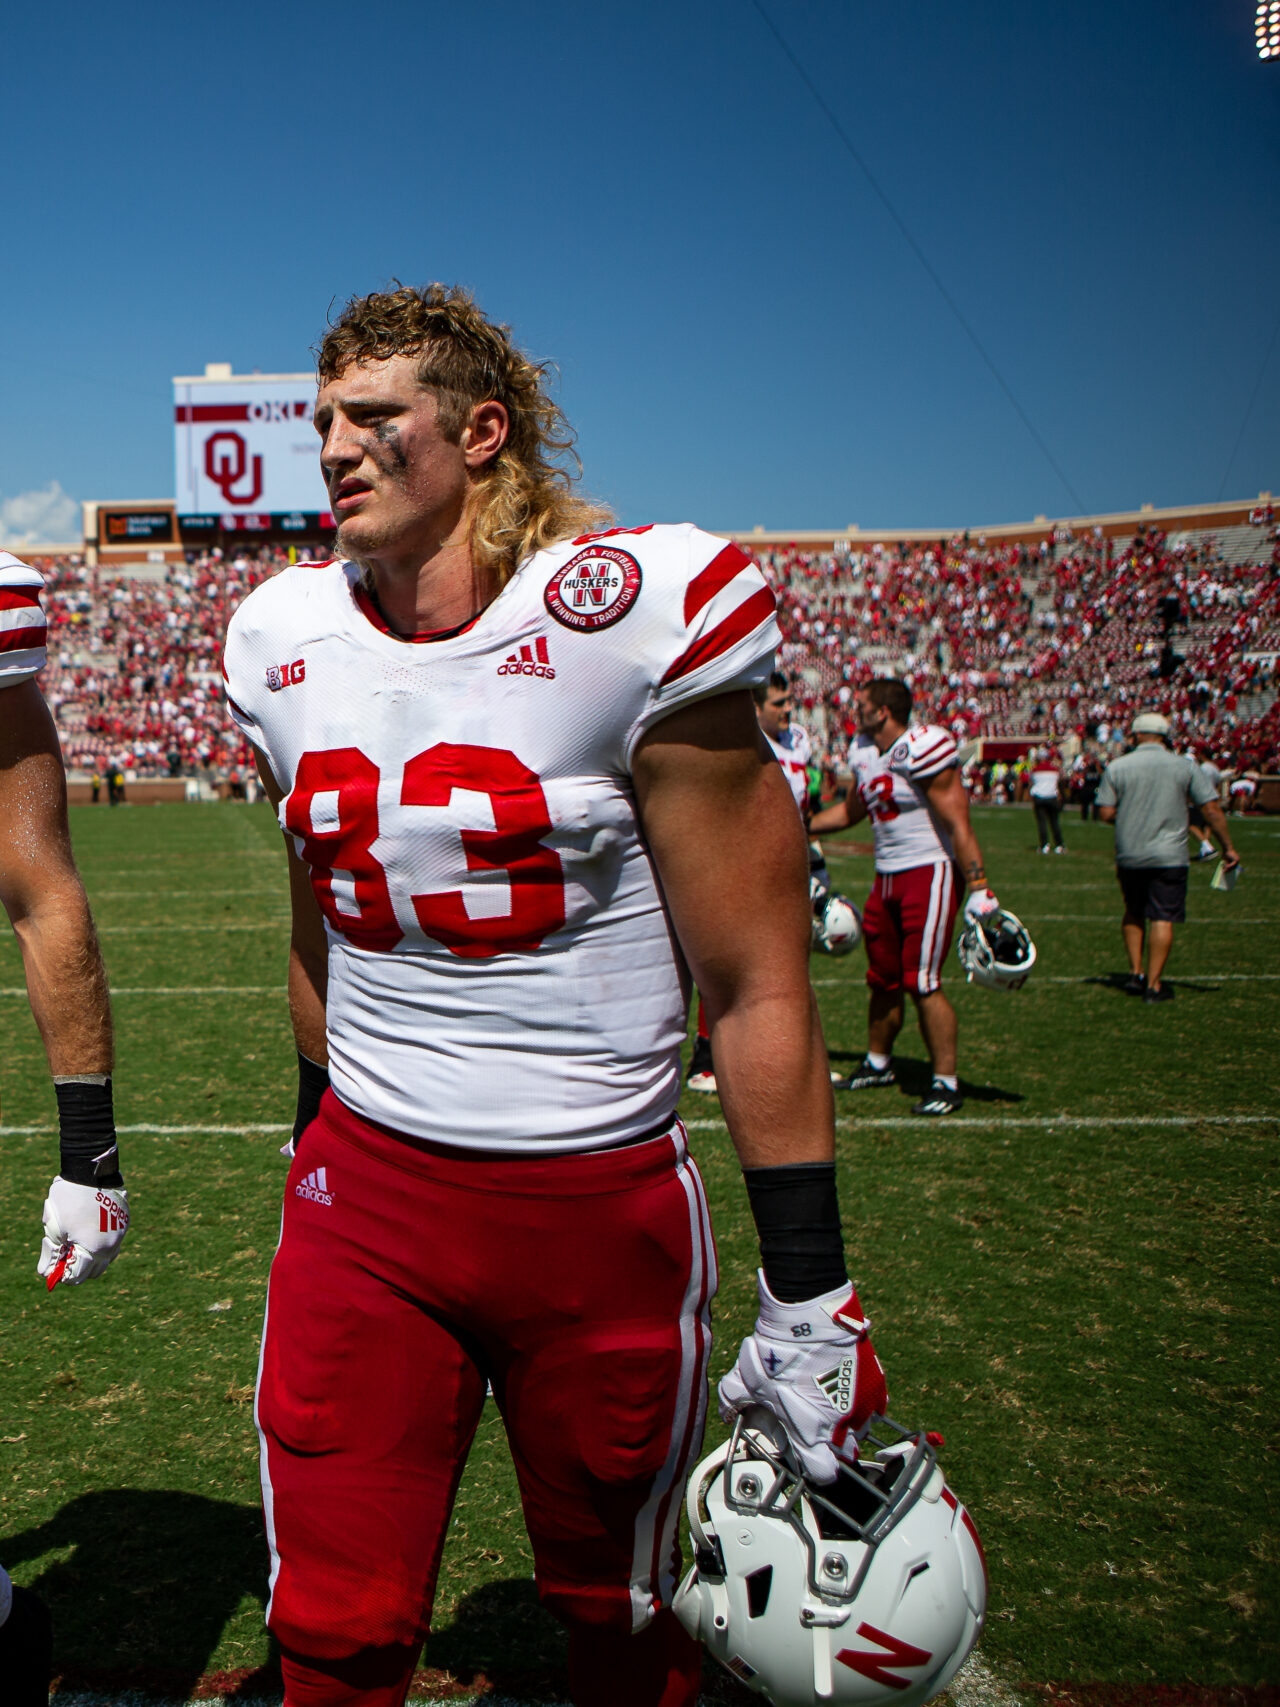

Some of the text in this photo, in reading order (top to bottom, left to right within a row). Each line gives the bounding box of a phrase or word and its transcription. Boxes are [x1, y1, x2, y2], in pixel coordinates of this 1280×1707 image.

[205, 430, 263, 505] OU
[553, 549, 635, 583] NEBRASKA FOOTBALL
[563, 577, 619, 590] HUSKERS
[551, 598, 586, 626] WINNING
[592, 587, 635, 625] TRADITION
[497, 660, 556, 680] adidas
[286, 741, 567, 959] 83
[296, 1184, 333, 1206] adidas
[790, 1322, 812, 1338] 83
[838, 1360, 853, 1411] adidas
[834, 1621, 933, 1690] N
